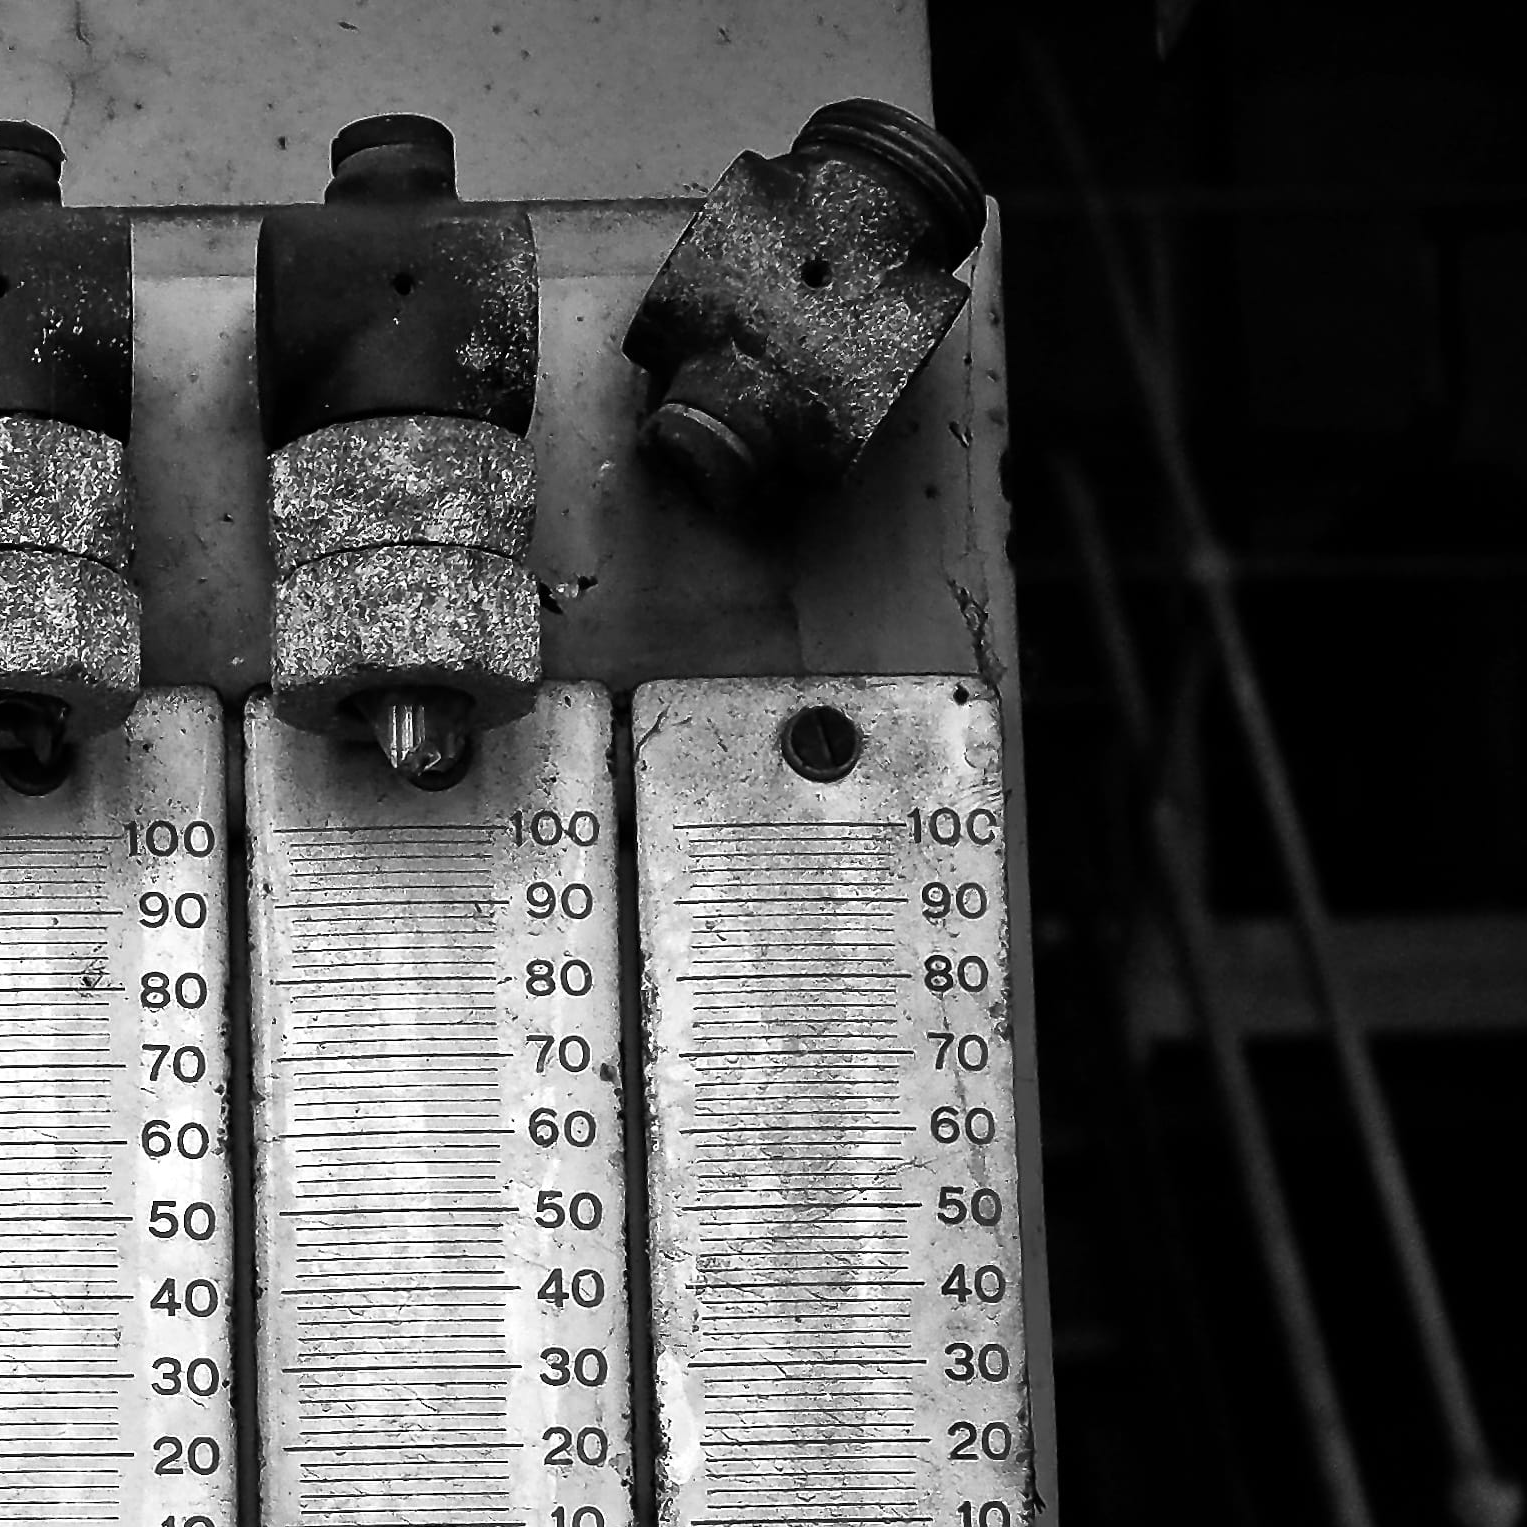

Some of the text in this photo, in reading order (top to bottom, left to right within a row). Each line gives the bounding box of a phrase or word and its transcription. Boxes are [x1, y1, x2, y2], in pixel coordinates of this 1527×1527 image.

[123, 820, 214, 857] 100
[511, 810, 600, 848] 100
[907, 807, 996, 847] 100
[139, 892, 206, 930] 90
[527, 882, 592, 919] 90
[922, 881, 988, 919] 90
[140, 972, 207, 1009] 80
[526, 959, 592, 997] 80
[924, 954, 987, 994] 80
[142, 1044, 205, 1083] 70
[525, 1035, 590, 1073] 70
[928, 1030, 992, 1070] 70
[141, 1120, 209, 1159] 60
[528, 1107, 596, 1148] 60
[931, 1106, 995, 1148] 60
[149, 1201, 215, 1240] 50
[535, 1190, 602, 1230] 50
[937, 1186, 1001, 1226] 50
[150, 1278, 217, 1317] 40
[537, 1268, 604, 1308] 40
[941, 1264, 1005, 1303] 40
[151, 1357, 219, 1396] 30
[540, 1347, 607, 1387] 30
[944, 1342, 1008, 1382] 30
[153, 1436, 219, 1476] 20
[542, 1427, 607, 1467] 20
[948, 1421, 1011, 1460] 20
